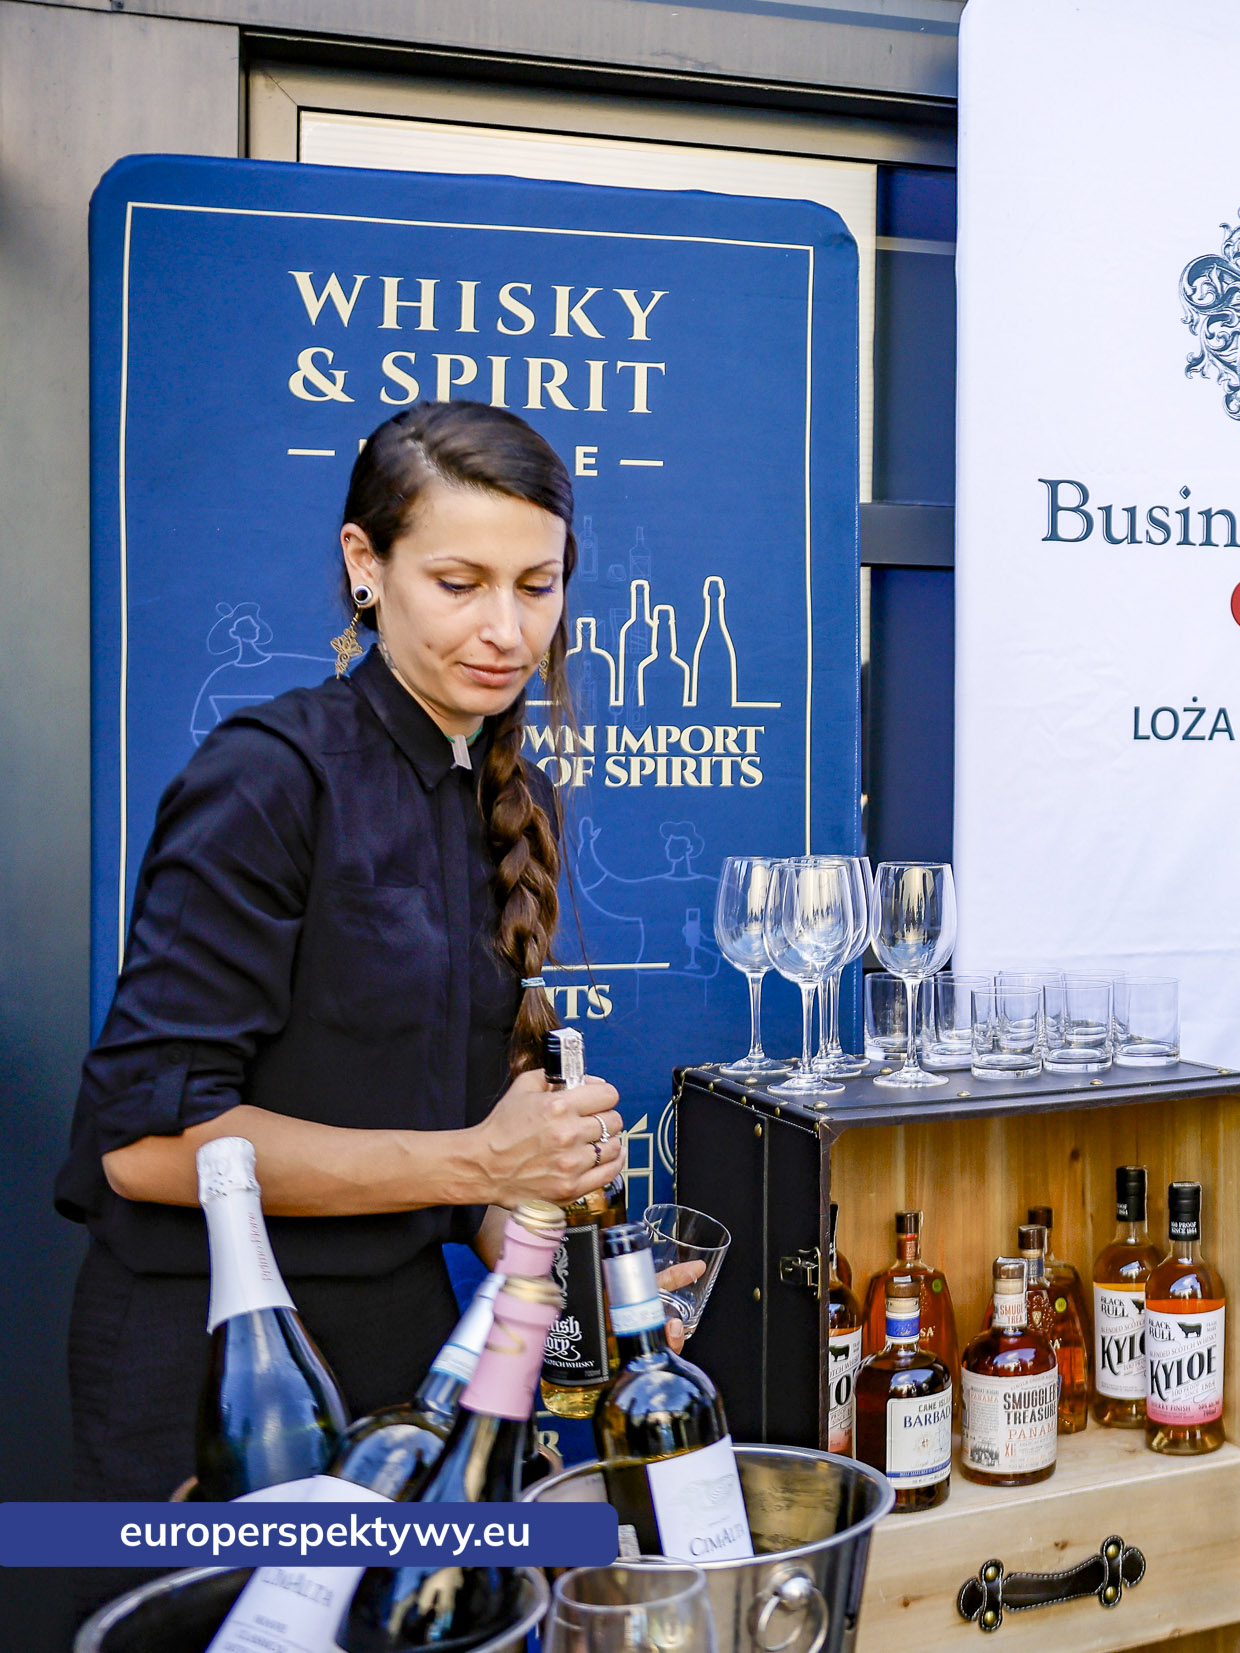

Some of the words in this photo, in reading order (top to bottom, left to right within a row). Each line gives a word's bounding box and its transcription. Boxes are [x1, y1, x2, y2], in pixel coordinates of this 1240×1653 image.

[287, 270, 669, 341] WHISKY
[288, 347, 355, 403] &
[380, 350, 666, 414] SPIRIT
[1133, 696, 1235, 742] LOŻA
[520, 724, 597, 754] WN
[605, 724, 765, 754] IMPORT
[536, 756, 597, 788] OF
[604, 756, 764, 789] SPIRITS
[1101, 1296, 1125, 1307] BLACK
[1101, 1304, 1129, 1318] BULL
[1148, 1318, 1171, 1330] BLACK
[1149, 1328, 1176, 1341] BULL
[1150, 1344, 1217, 1402] KYLOE
[1004, 1401, 1057, 1425] TREASURE
